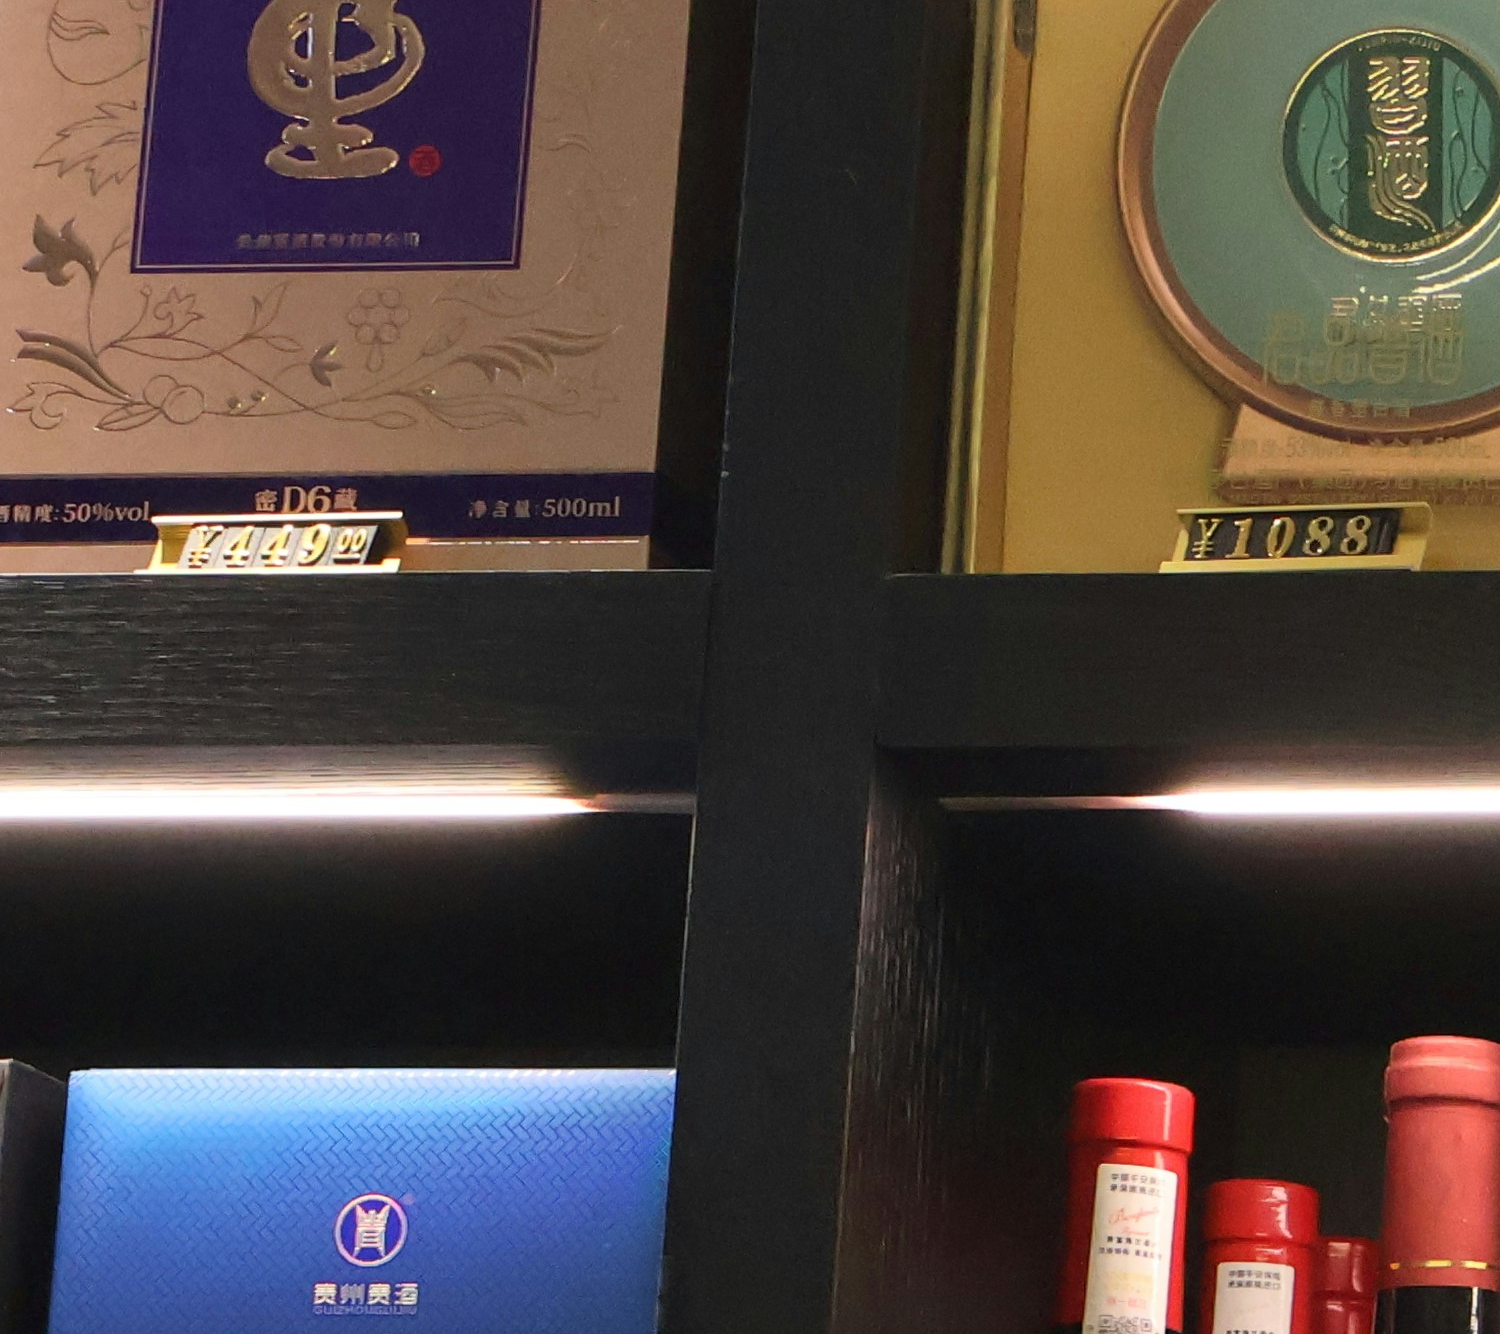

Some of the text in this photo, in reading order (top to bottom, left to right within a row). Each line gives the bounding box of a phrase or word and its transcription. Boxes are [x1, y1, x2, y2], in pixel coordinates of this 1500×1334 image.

[1192, 515, 1371, 558] ¥1088
[313, 1283, 418, 1307] 贵州贵酒
